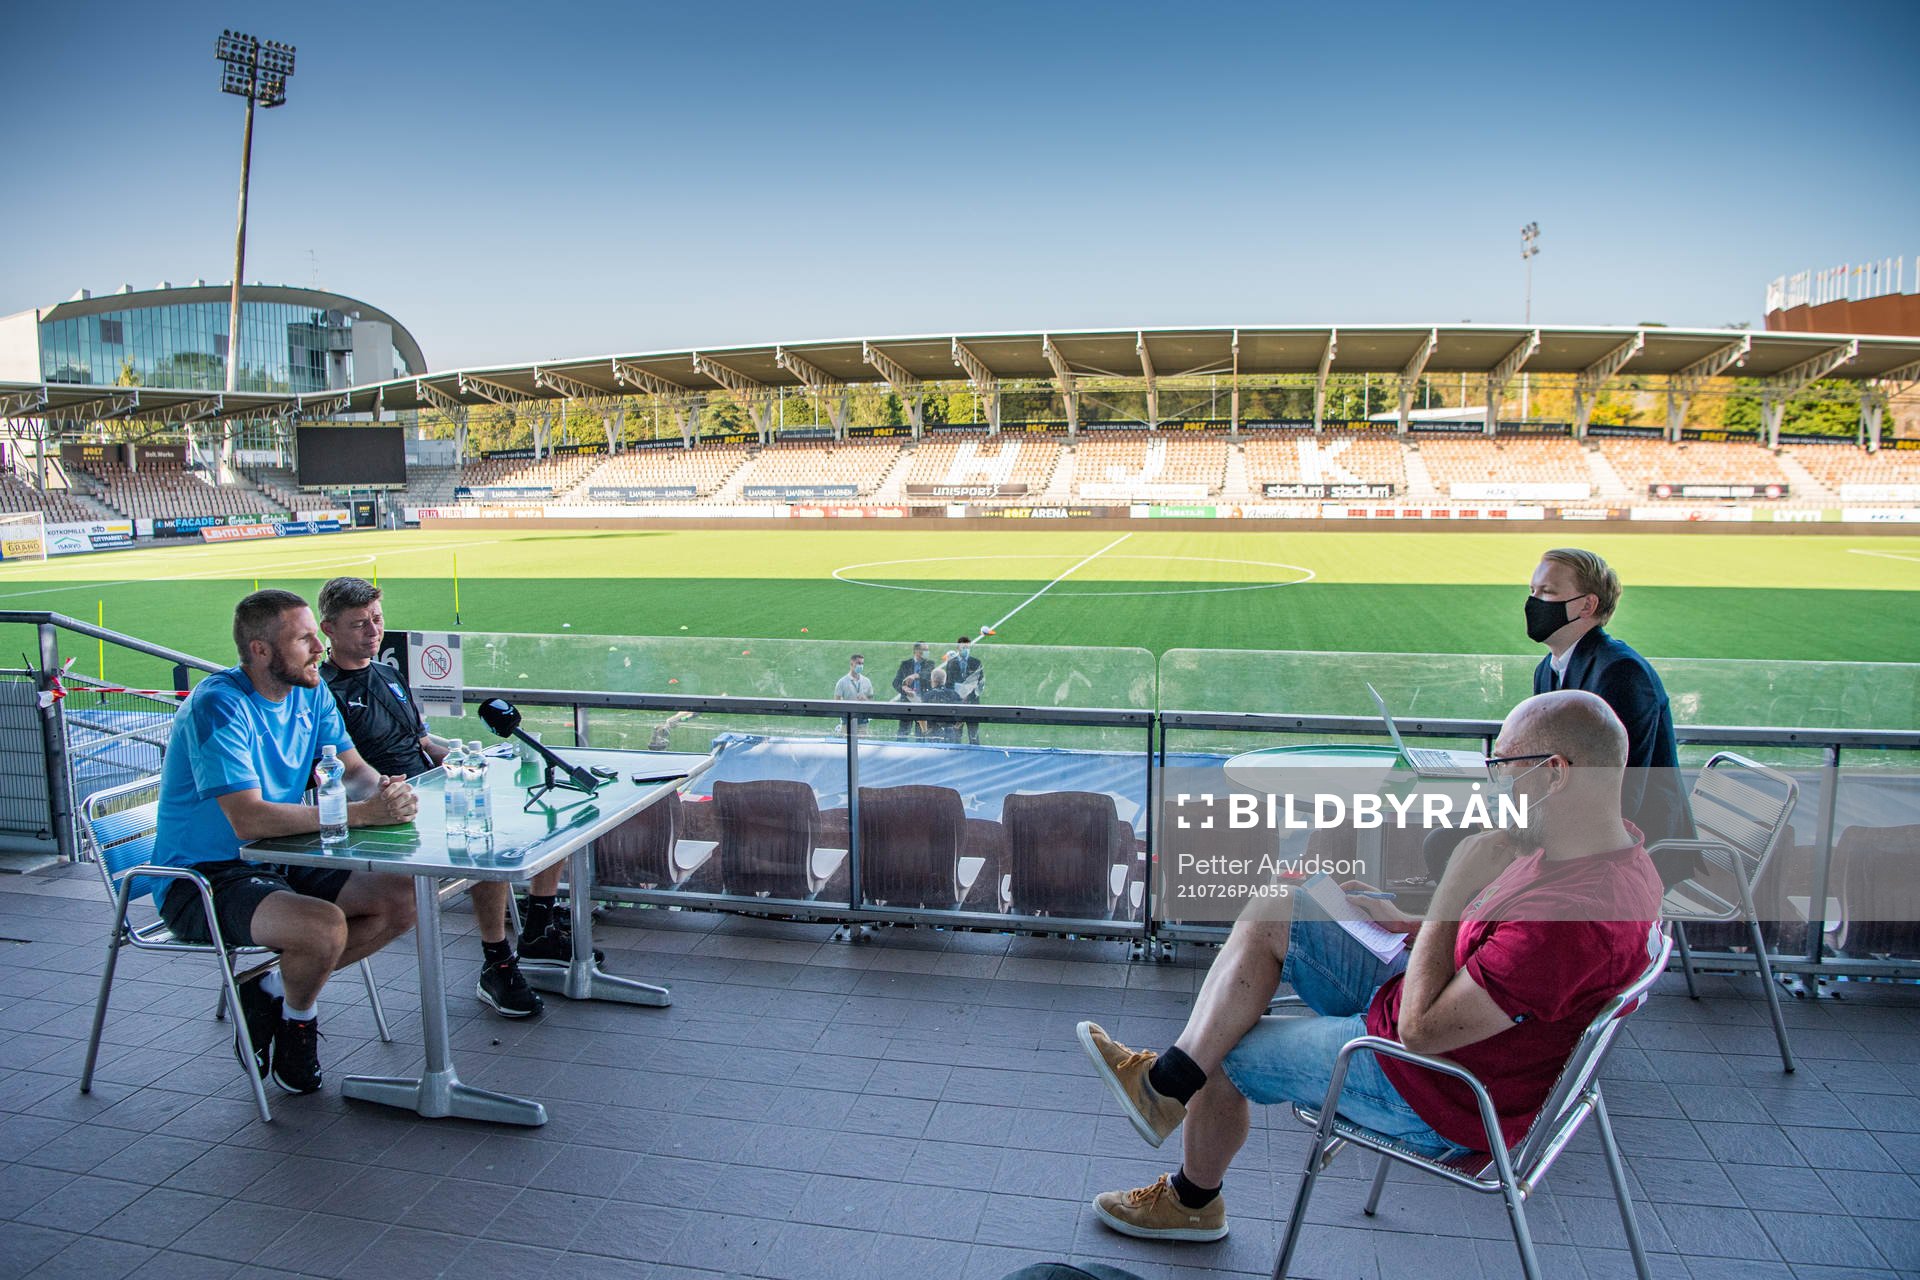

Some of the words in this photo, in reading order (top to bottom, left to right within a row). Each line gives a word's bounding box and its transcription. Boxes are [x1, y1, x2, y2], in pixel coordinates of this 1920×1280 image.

[83, 447, 103, 455] BOLT
[1267, 485, 1324, 498] stadium
[1331, 485, 1389, 498] stadium
[1031, 509, 1068, 518] ARENA
[175, 517, 214, 527] FACADE
[48, 528, 86, 536] KOTKOMILLS
